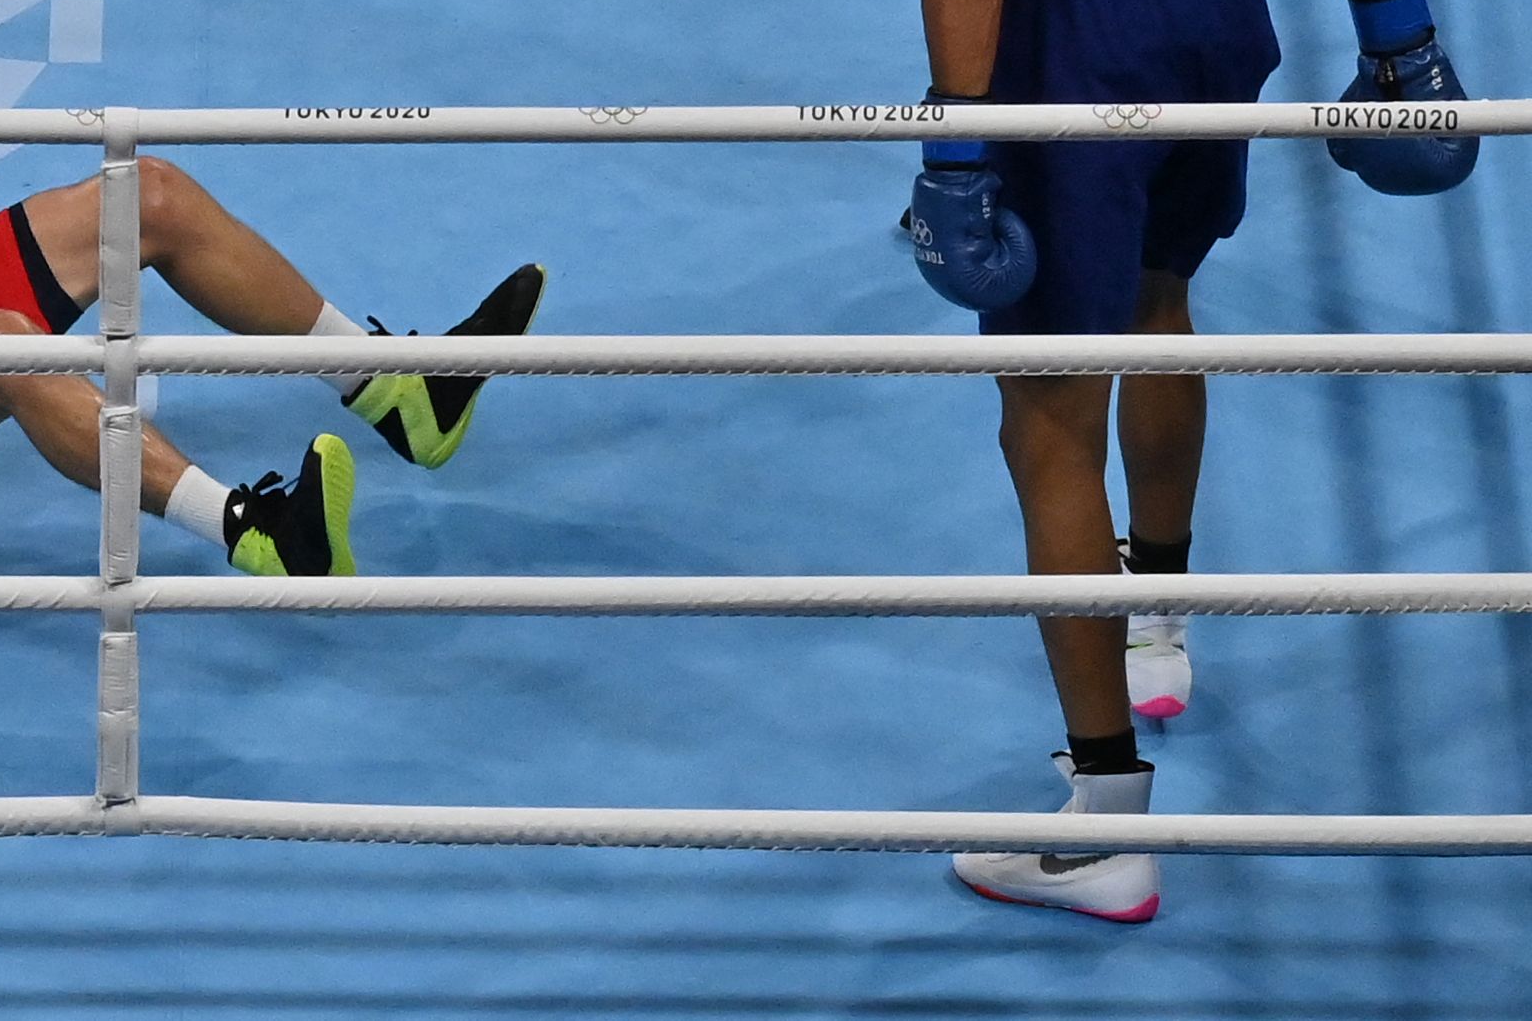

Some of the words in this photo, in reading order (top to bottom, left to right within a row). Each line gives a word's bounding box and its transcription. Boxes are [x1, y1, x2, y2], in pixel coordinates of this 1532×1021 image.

[798, 106, 878, 122] TOKYO
[884, 106, 945, 122] 2020
[1311, 106, 1392, 129] TOKYO
[1397, 108, 1459, 130] 2020
